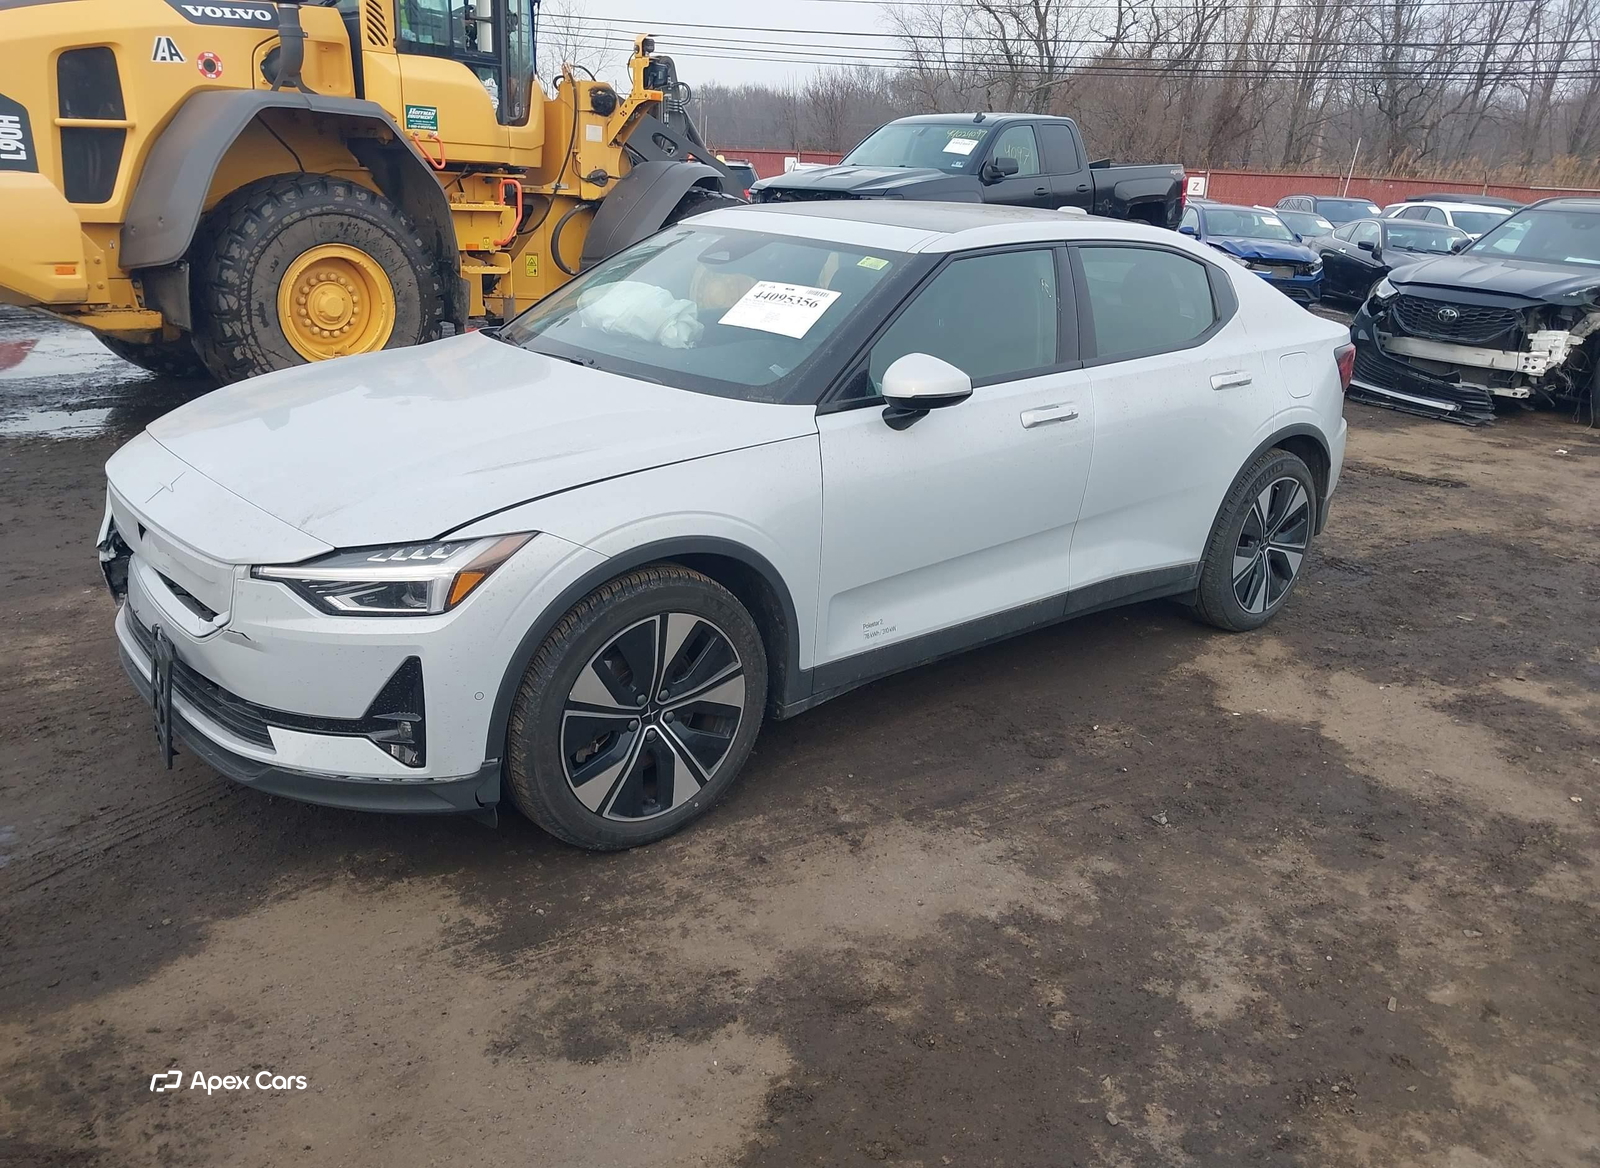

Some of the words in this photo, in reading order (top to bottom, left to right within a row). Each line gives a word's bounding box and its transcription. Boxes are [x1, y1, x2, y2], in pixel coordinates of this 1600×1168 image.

[181, 5, 272, 21] VOLVO
[0, 115, 27, 160] L90H
[1192, 181, 1200, 191] Z
[754, 291, 820, 308] 44095356
